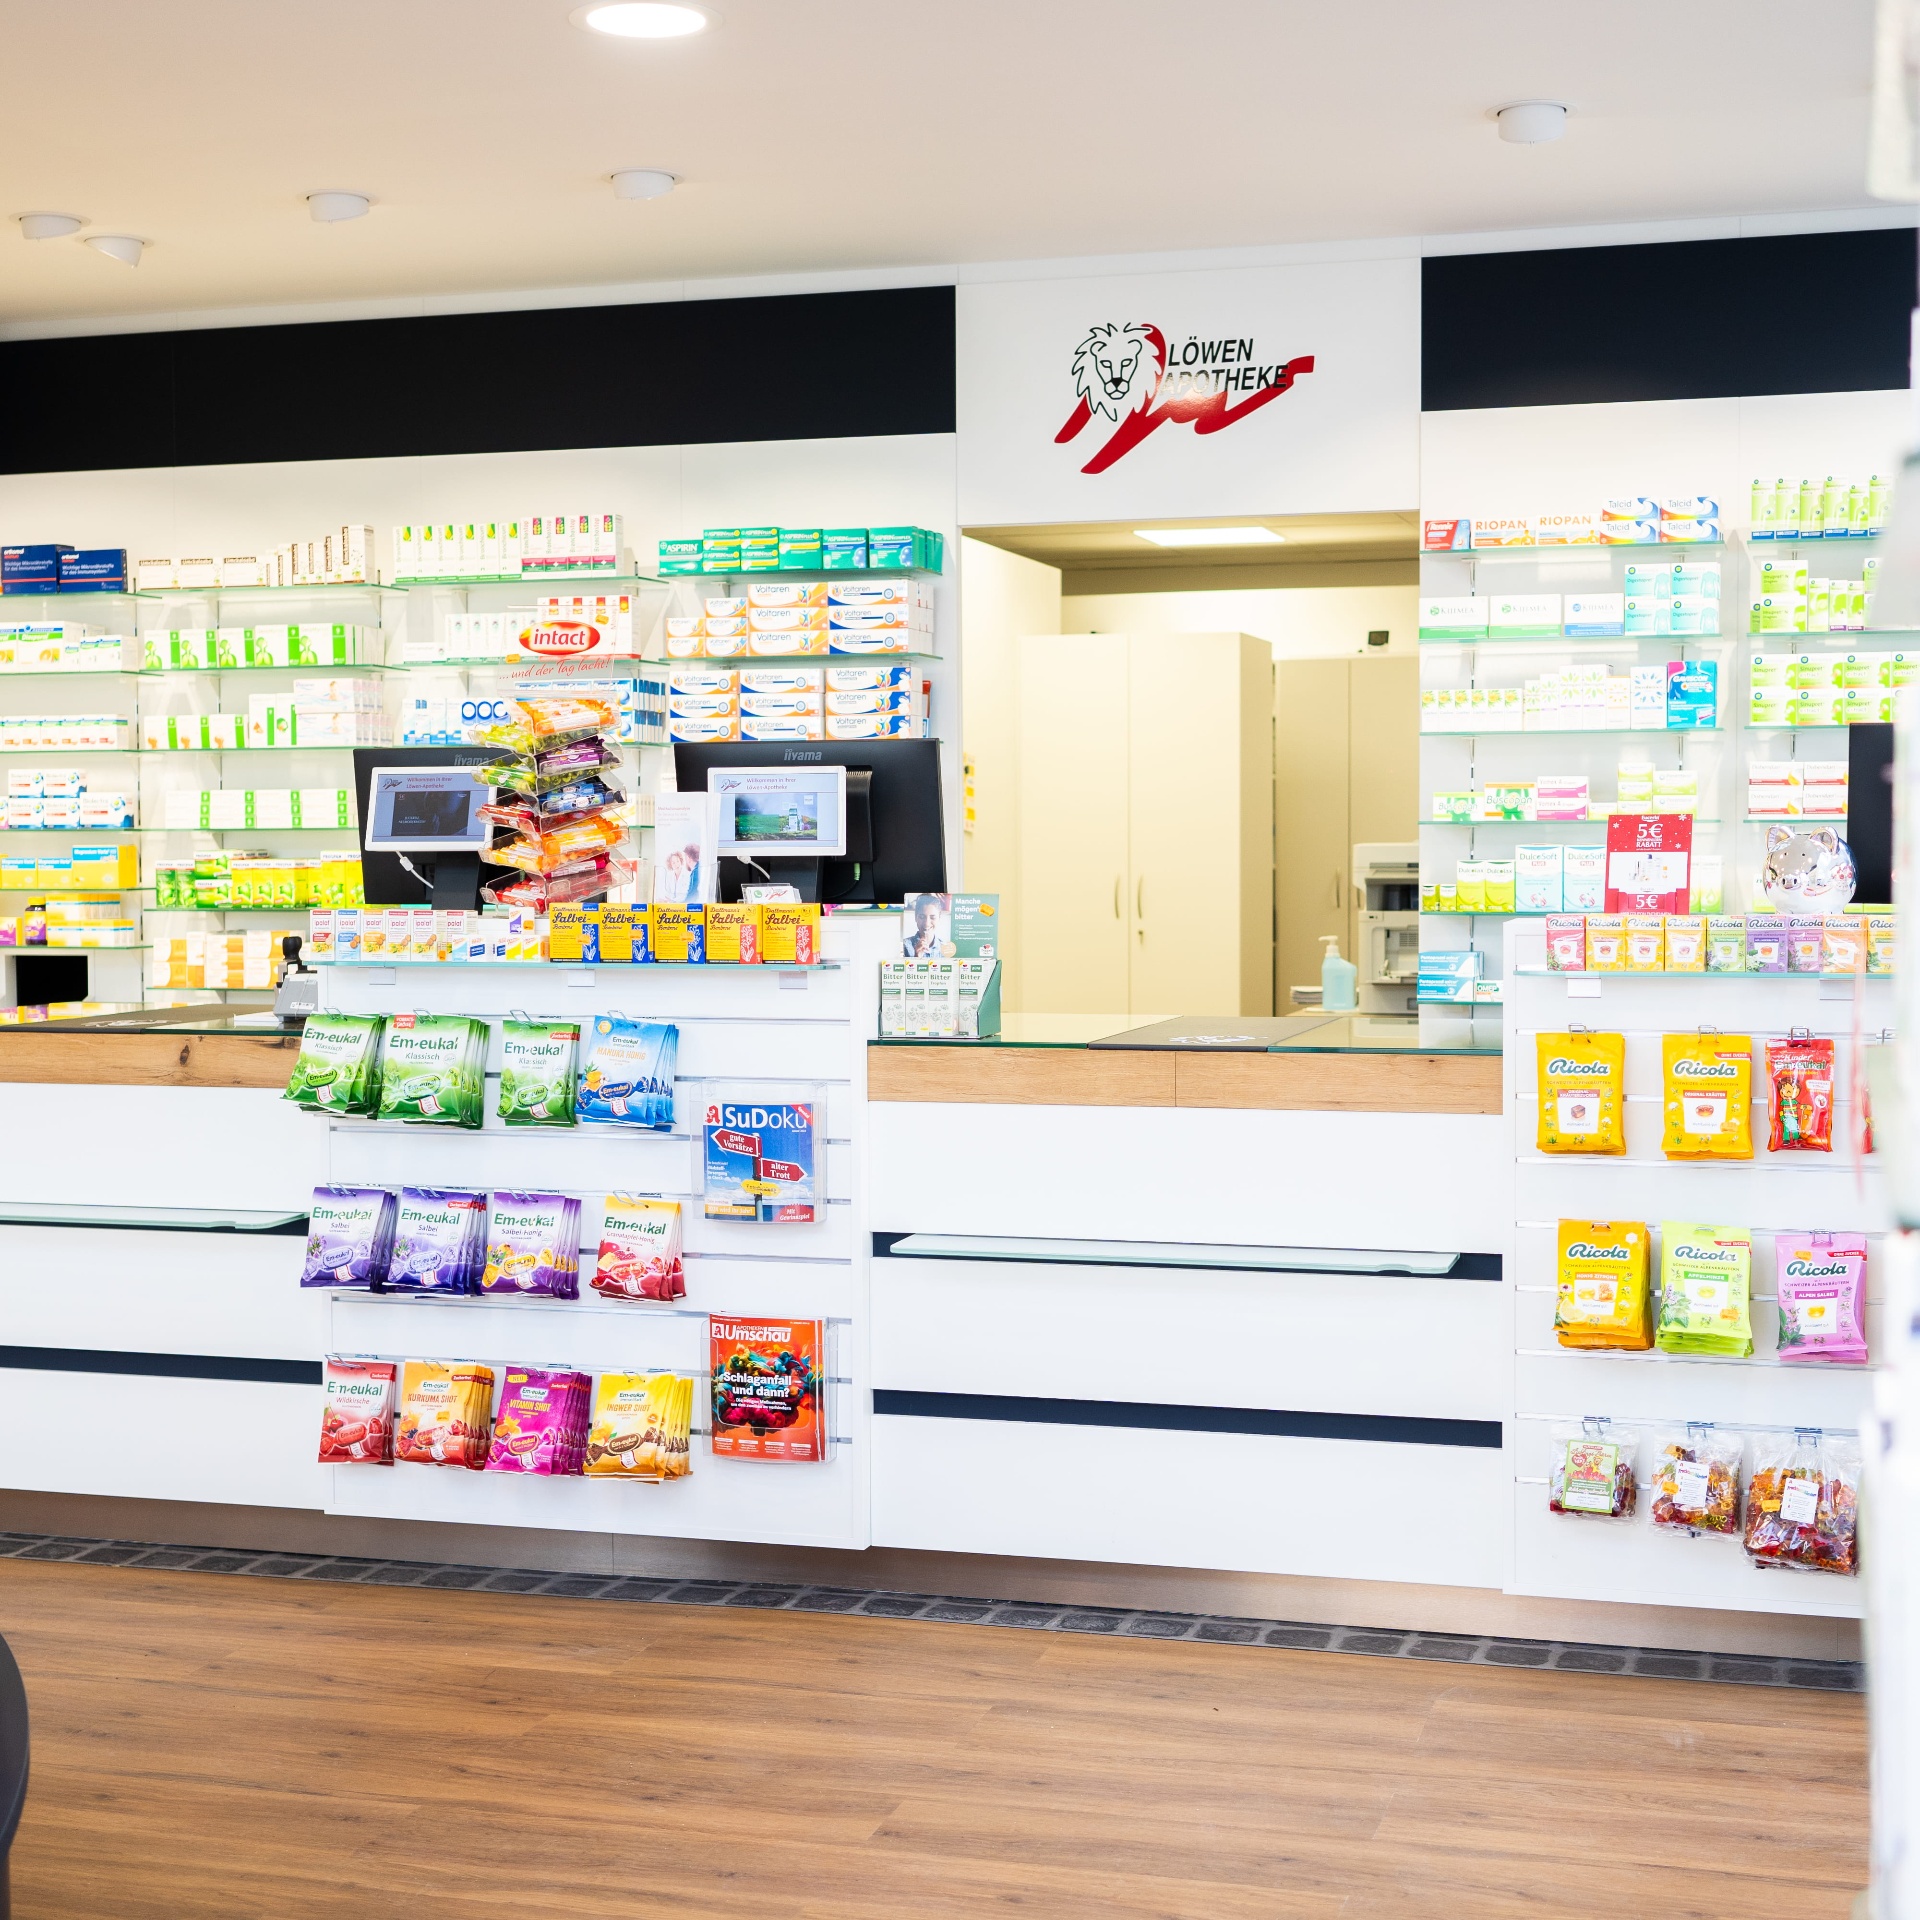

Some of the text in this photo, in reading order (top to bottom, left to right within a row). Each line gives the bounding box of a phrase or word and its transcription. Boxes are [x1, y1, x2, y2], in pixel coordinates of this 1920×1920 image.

[1168, 336, 1254, 367] LÖWEN
[1160, 364, 1290, 396] APOTHEKE
[1608, 499, 1632, 509] Talcid
[1668, 499, 1692, 508] Talcid
[1475, 520, 1527, 530] RIOPAN
[1539, 515, 1591, 526] RIOPAN
[1606, 522, 1629, 532] Talcid
[1666, 521, 1691, 531] Talcid
[666, 543, 699, 554] ASPIRIN
[755, 585, 790, 595] Voltaren
[842, 585, 871, 594] Voltaren
[756, 608, 791, 618] Voltaren
[843, 609, 871, 617] Voltaren
[534, 628, 586, 646] intact
[757, 632, 791, 642] Voltaren
[843, 633, 871, 641] Voltaren
[536, 666, 555, 676] der
[557, 659, 575, 678] Tag
[578, 657, 611, 671] lacht!
[755, 673, 783, 681] Voltaren
[836, 669, 867, 678] Voltaren
[755, 697, 783, 705] Voltaren
[837, 693, 867, 702] Voltaren
[756, 721, 784, 729] Voltaren
[836, 717, 866, 726] Voltaren
[784, 748, 822, 762] iiyama
[1486, 795, 1533, 806] Buscopan
[1438, 802, 1478, 812] Buscopan
[1637, 823, 1664, 838] 5€
[1519, 853, 1557, 861] DulceSoft
[1568, 852, 1606, 861] DulceSoft
[1635, 895, 1659, 908] 5€
[339, 919, 356, 927] ipalat
[365, 919, 382, 927] ipalat
[552, 912, 591, 924] Salbei-
[602, 912, 640, 924] Salbei-
[656, 912, 696, 924] Salbei-
[710, 912, 749, 924] Salbei-
[765, 913, 805, 924] Salbei-
[1548, 918, 1582, 928] Ricola
[1588, 918, 1621, 927] Ricola
[1627, 918, 1660, 928] Ricola
[1667, 918, 1700, 928] Ricola
[1789, 918, 1824, 928] Ricola
[1709, 919, 1743, 928] Ricola
[1748, 919, 1784, 929] Ricola
[1825, 918, 1860, 929] Ricola
[304, 1028, 363, 1045] Em-eukal
[612, 1036, 639, 1045] Em-eukal
[315, 1043, 343, 1051] Klassisch
[390, 1035, 458, 1050] Em-eukal
[504, 1042, 564, 1056] Em-eukal
[597, 1047, 647, 1060] MANUKA HONIG
[405, 1053, 440, 1061] Klassisch
[518, 1057, 547, 1065] Klassisch
[1548, 1058, 1609, 1074] Ricola
[1674, 1060, 1736, 1076] Ricola
[725, 1106, 807, 1129] SuDoku
[729, 1134, 745, 1143] gute
[723, 1139, 754, 1153] Vorsätze
[771, 1163, 789, 1171] alter
[770, 1170, 791, 1180] Trott
[312, 1206, 373, 1221] Em-eukal
[401, 1207, 461, 1225] Em-eukal
[331, 1221, 351, 1229] Salbei
[494, 1213, 555, 1228] Em-eukal
[418, 1224, 439, 1232] Salbei
[604, 1216, 667, 1236] Em-eukal
[501, 1228, 543, 1237] Salbei-Honig
[606, 1231, 656, 1245] Granatapfel-Honig
[1568, 1243, 1629, 1259] Ricola
[1674, 1245, 1737, 1262] Ricola
[1786, 1260, 1847, 1276] Ricola
[1687, 1273, 1725, 1281] APFELMINZE
[724, 1324, 792, 1343] Umschau
[723, 1372, 792, 1386] Schlaganfall
[327, 1381, 382, 1396] Em-eukal
[422, 1381, 450, 1389] Em-eukal
[522, 1387, 547, 1396] Em-eukal
[619, 1391, 646, 1399] Em-eukal
[732, 1386, 790, 1398] und dann?
[336, 1396, 370, 1405] Wildkirsche
[407, 1393, 458, 1403] KURKUMA SHOT
[509, 1398, 551, 1412] VITAMIN SHOT
[606, 1404, 651, 1412] INGWER SHOT
